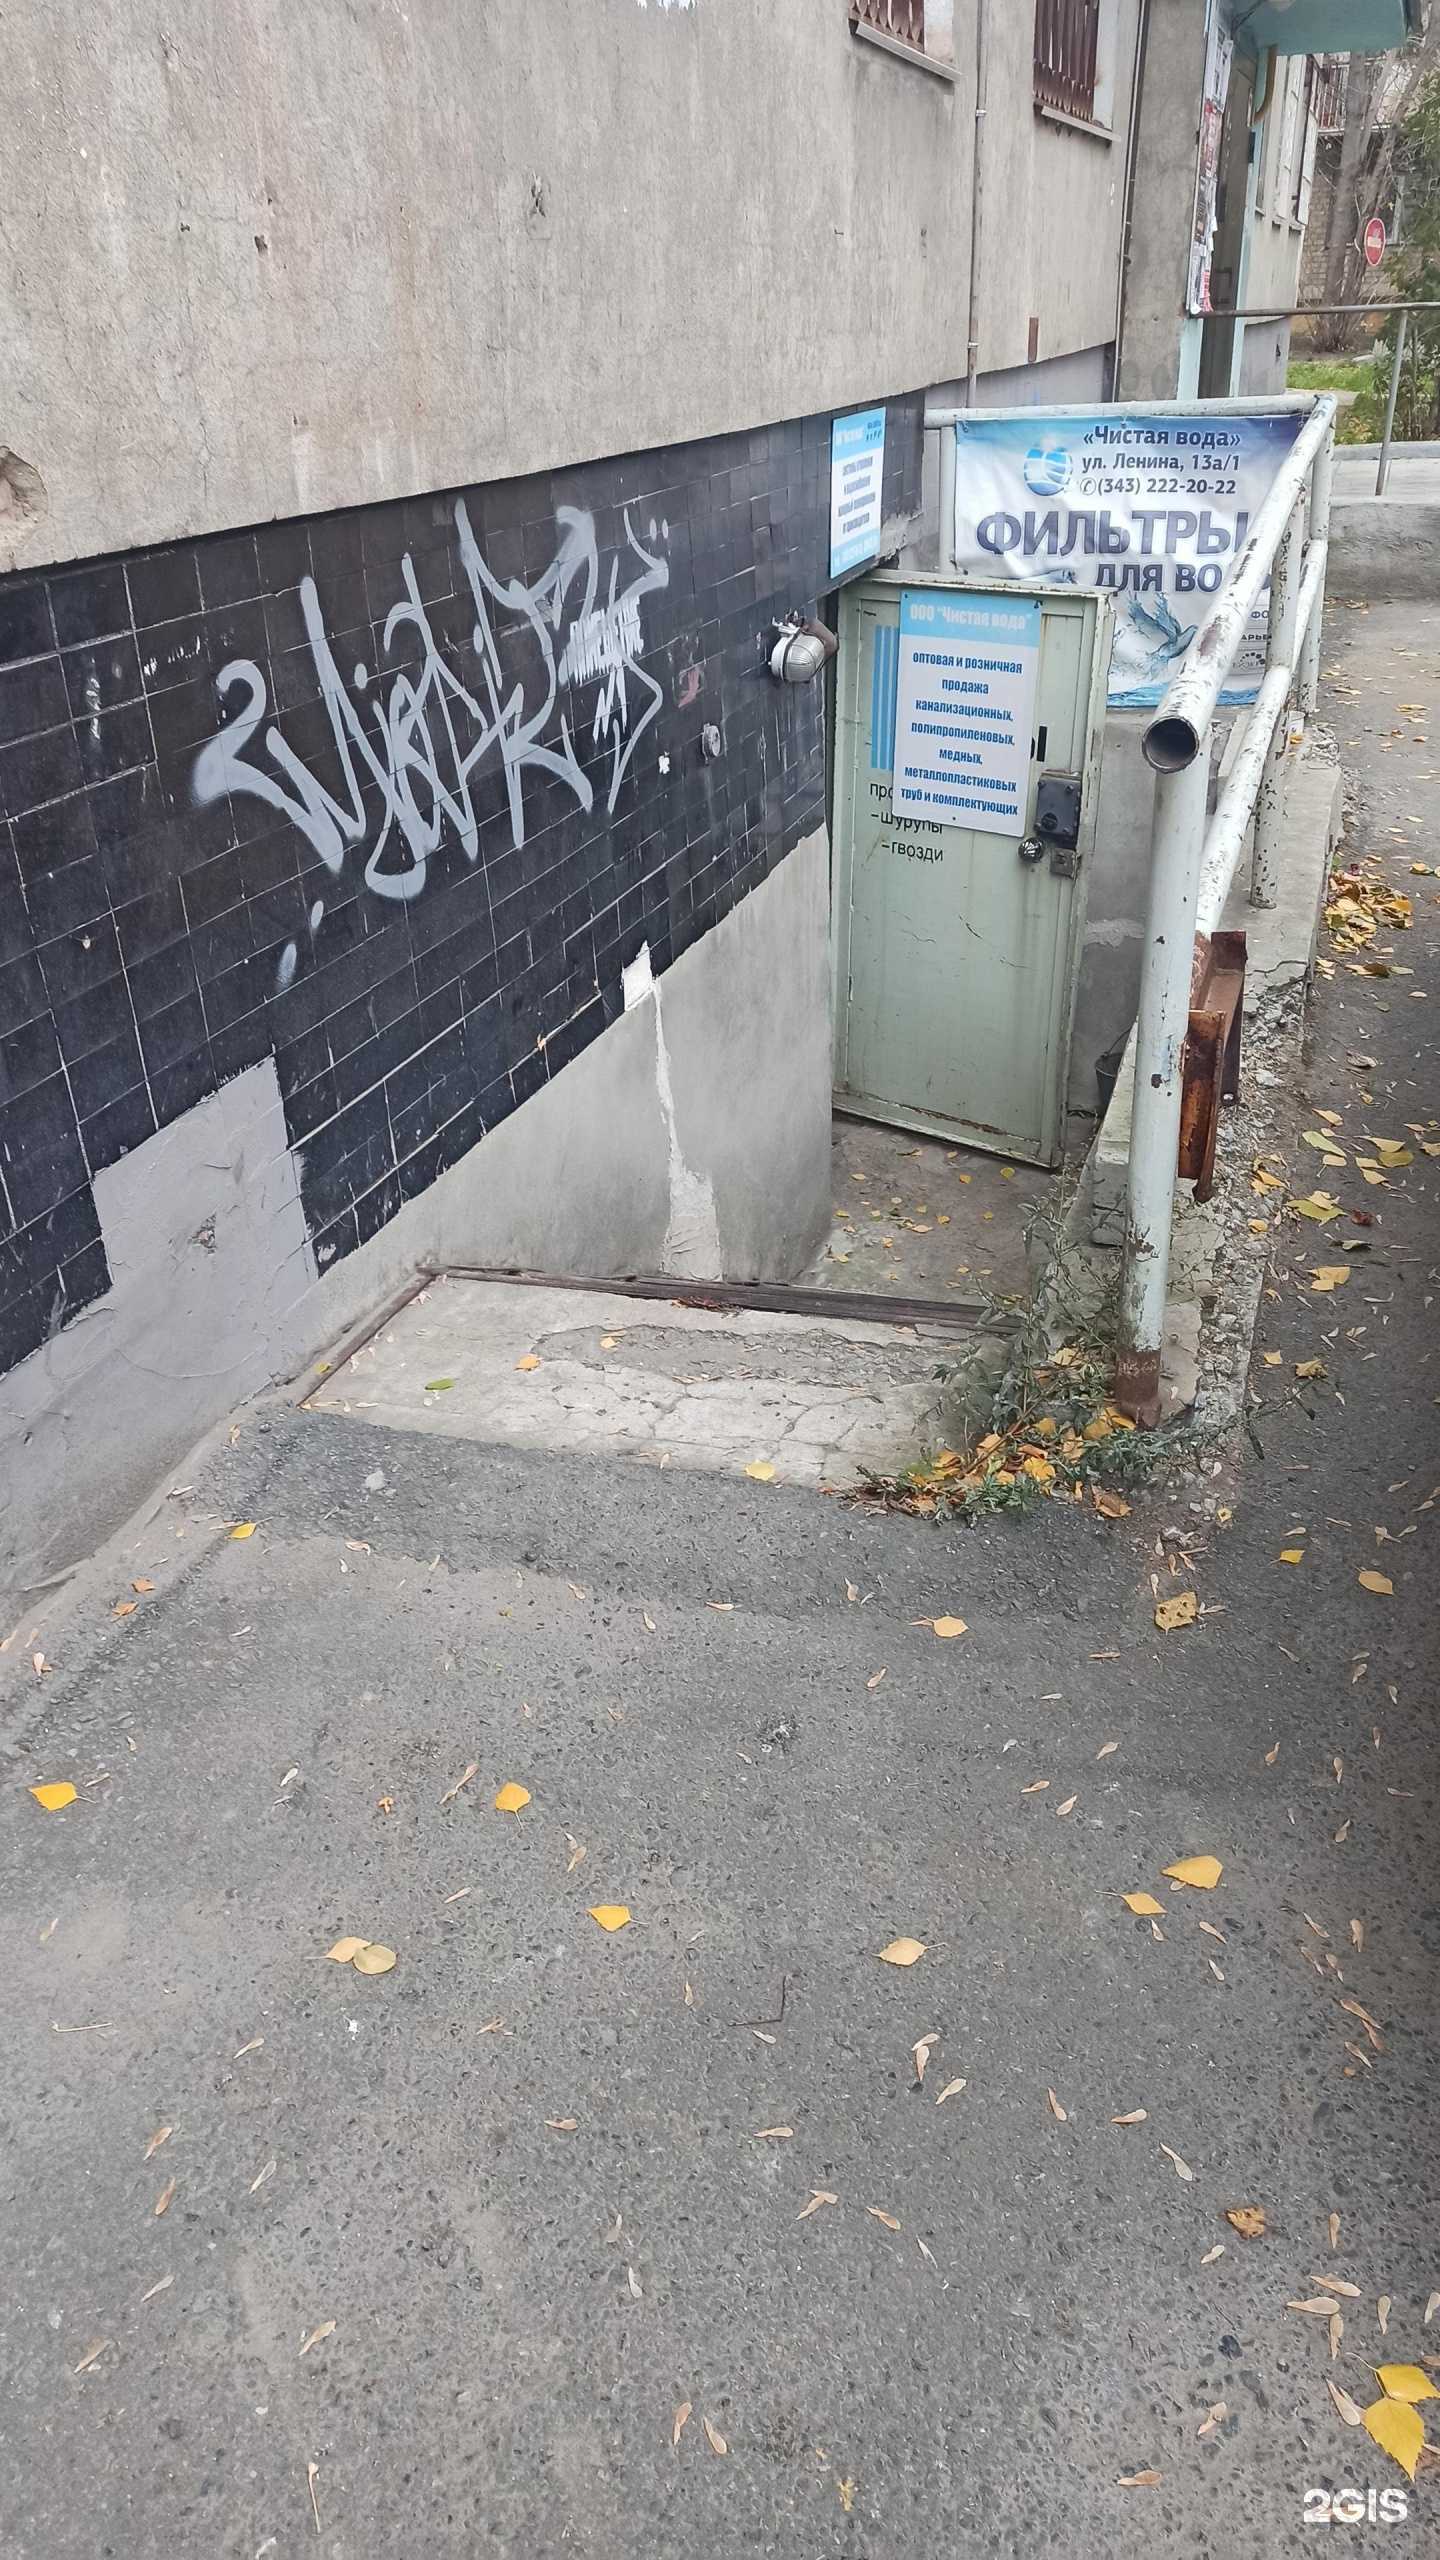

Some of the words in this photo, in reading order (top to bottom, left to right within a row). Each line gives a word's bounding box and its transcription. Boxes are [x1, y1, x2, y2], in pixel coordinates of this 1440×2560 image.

[1083, 425, 1169, 445] «Чистая
[1175, 430, 1241, 450] вода»
[1082, 455, 1107, 473] ул.
[1112, 453, 1185, 472] Ленина,
[1192, 454, 1240, 471] 13а/1
[1098, 477, 1141, 496] (343)
[1146, 478, 1237, 495] 222-20-22
[976, 510, 1249, 557] ФИЛЬТРЫ
[1094, 563, 1164, 592] ДЛЯ
[909, 603, 935, 621] ООО
[912, 651, 955, 667] оптовая
[956, 659, 964, 668] и
[964, 657, 1023, 674] розничная
[941, 678, 990, 695] продажа
[915, 700, 1014, 721] канализационных,
[911, 722, 1016, 746] полипропиленовых,
[938, 749, 983, 765] медных,
[904, 766, 1017, 792] металлопластиковых
[900, 787, 923, 801] труб
[924, 791, 931, 801] и
[932, 793, 1018, 816] комплектующих
